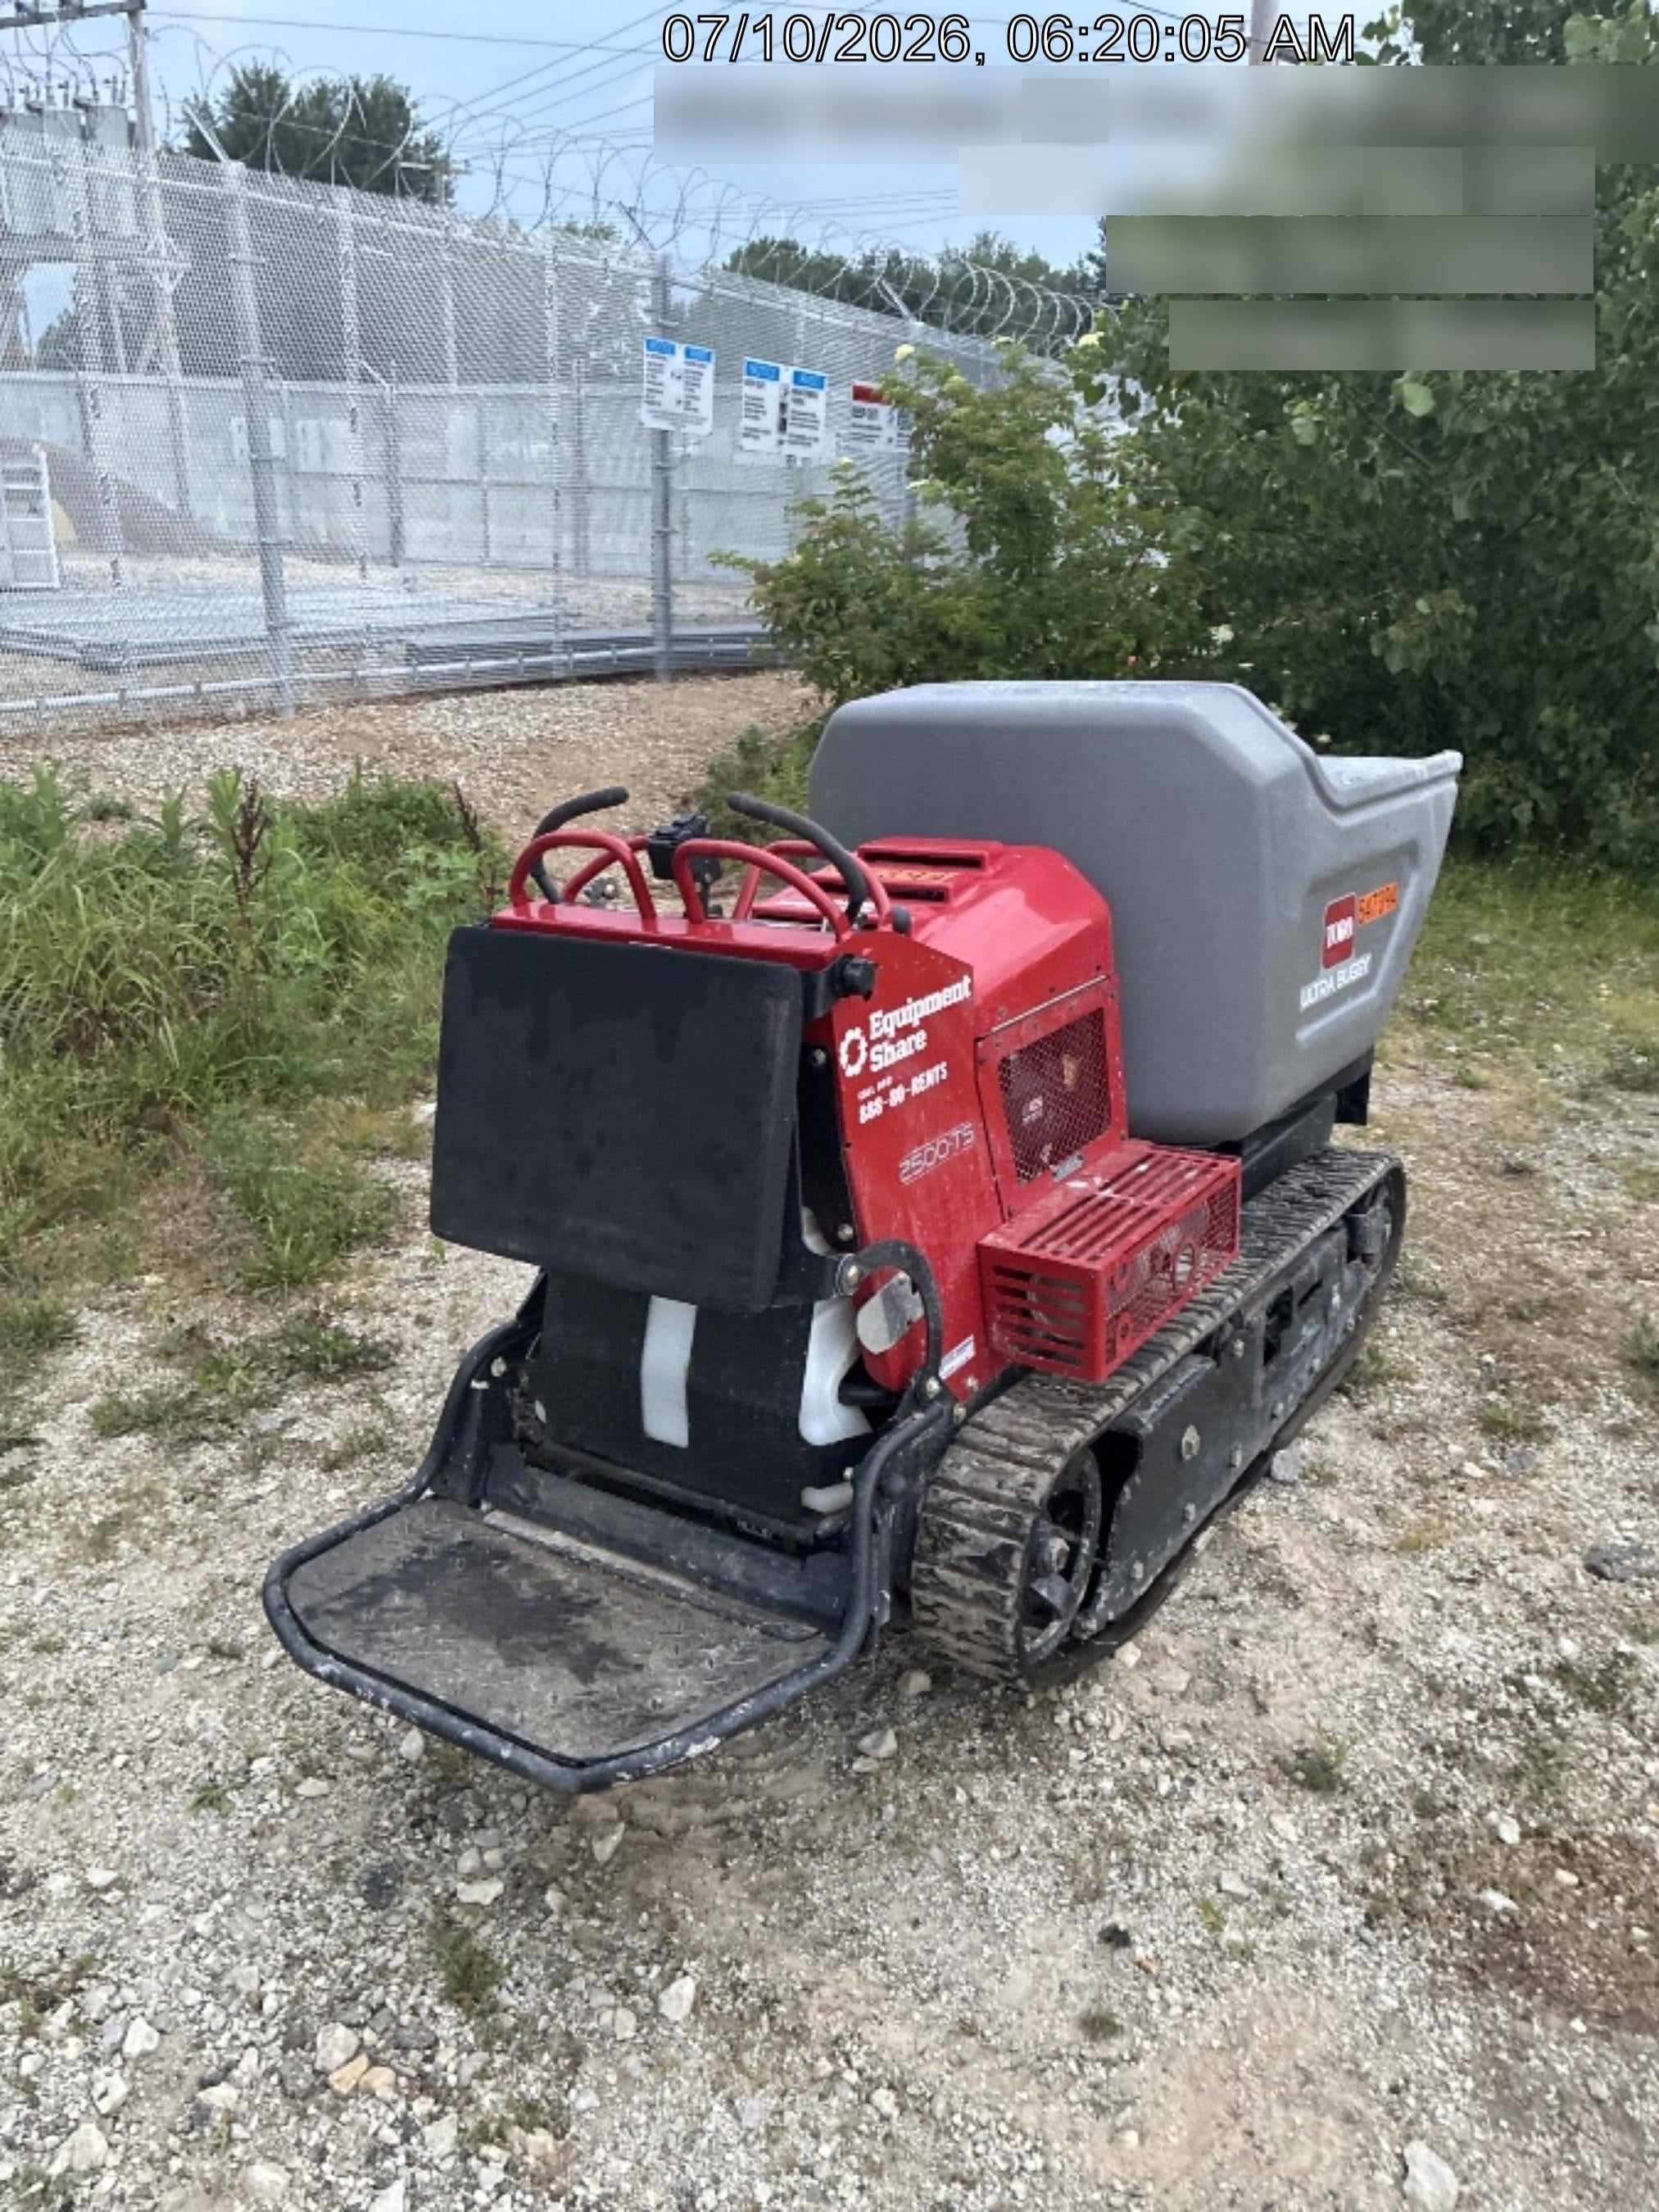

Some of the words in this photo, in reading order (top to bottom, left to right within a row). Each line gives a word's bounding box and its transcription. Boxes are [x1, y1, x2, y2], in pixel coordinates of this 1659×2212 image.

[869, 975, 971, 1040] Equipment
[1300, 976, 1335, 1012] ULTRA
[1336, 952, 1372, 989] BUGGY
[870, 1030, 927, 1072] Share
